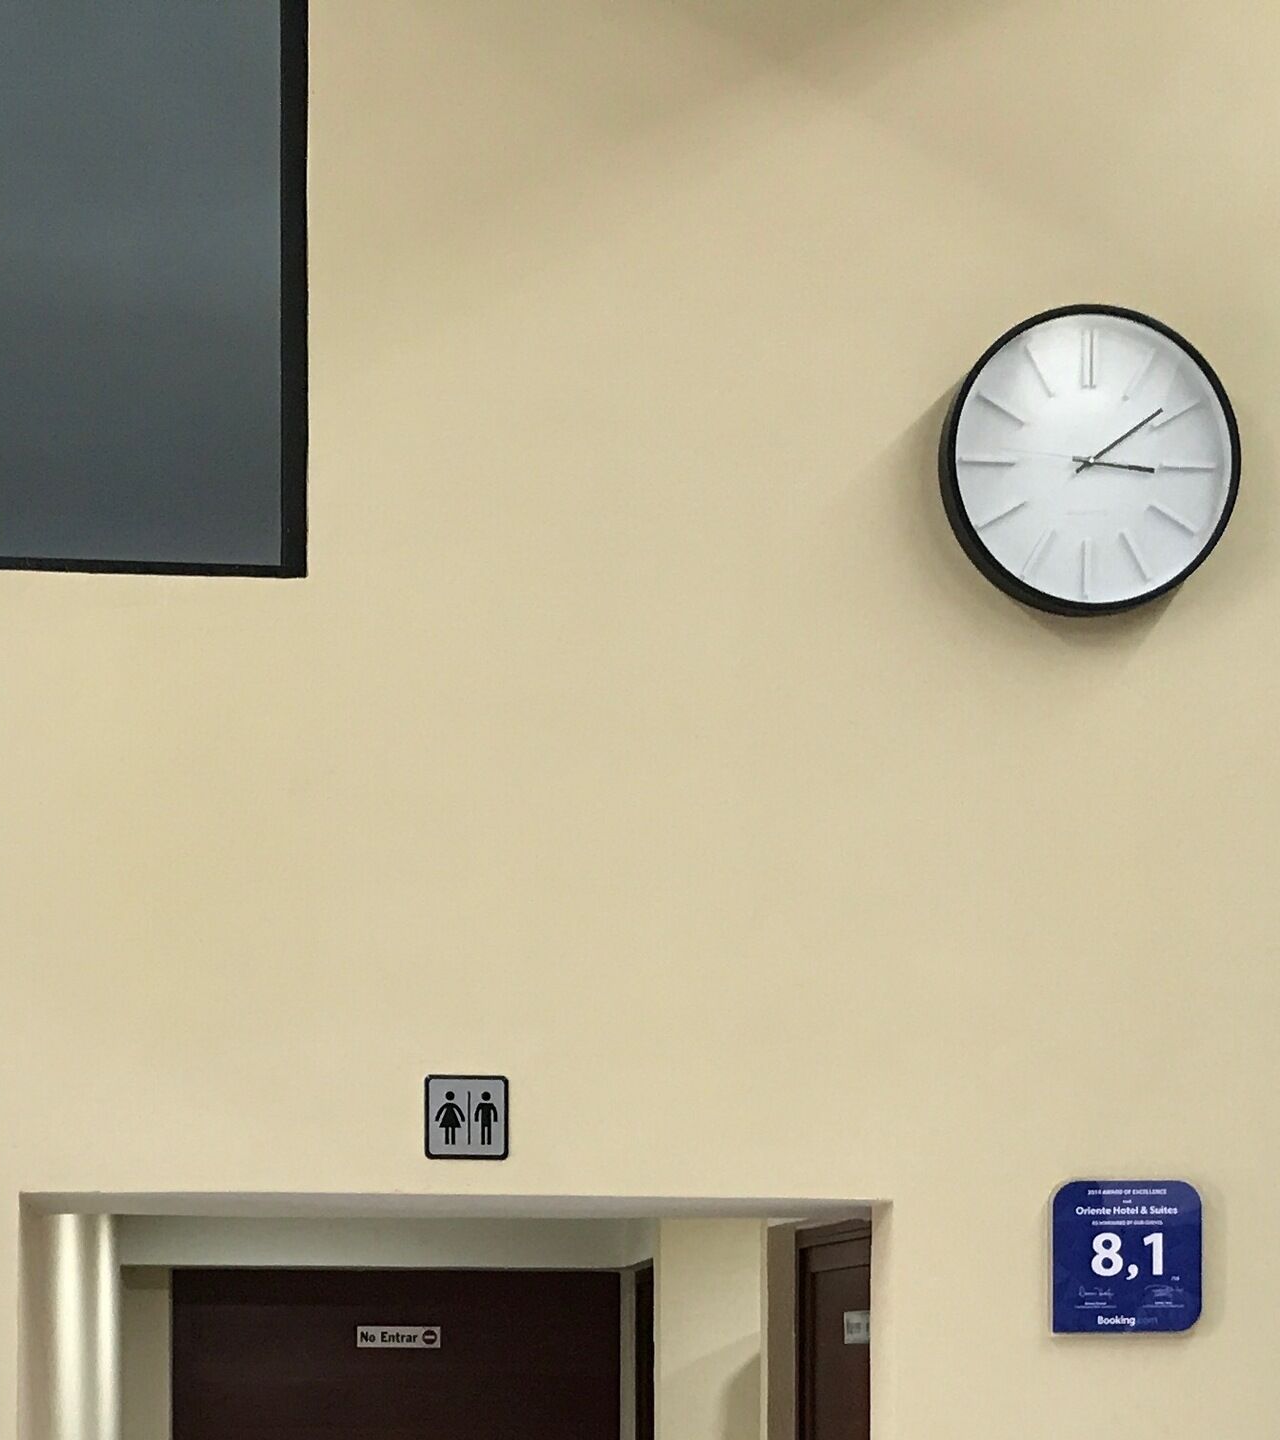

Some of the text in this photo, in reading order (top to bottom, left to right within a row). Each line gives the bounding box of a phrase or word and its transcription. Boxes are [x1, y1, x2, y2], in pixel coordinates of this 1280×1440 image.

[1075, 1206, 1178, 1215] Oriente Hotel & Suites
[1091, 1232, 1163, 1281] 8,1
[360, 1331, 418, 1343] No Entrar
